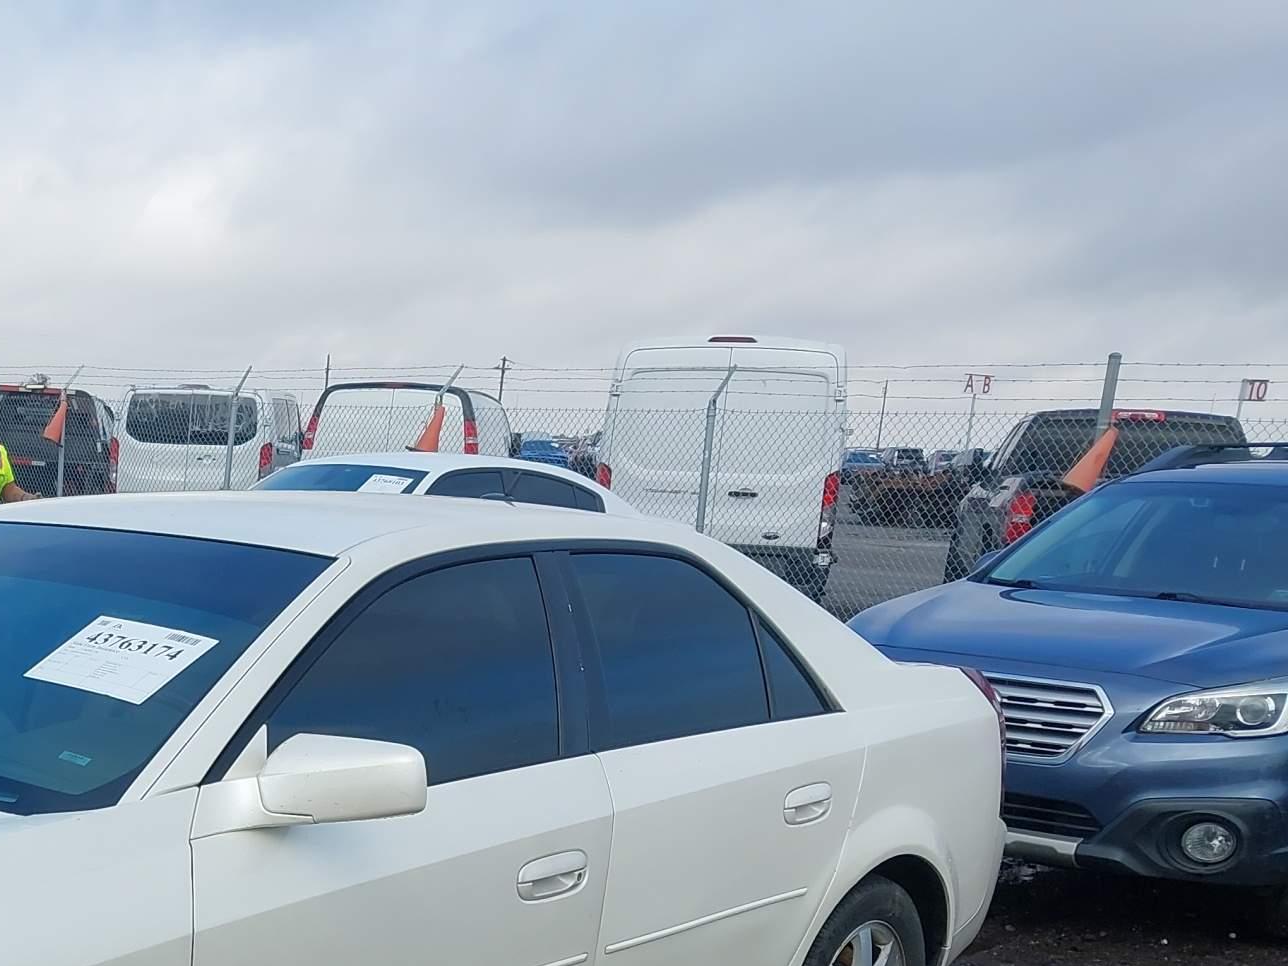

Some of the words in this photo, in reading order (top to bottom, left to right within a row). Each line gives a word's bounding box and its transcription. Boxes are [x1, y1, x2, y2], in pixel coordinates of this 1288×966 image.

[964, 375, 974, 393] A
[982, 376, 992, 394] B
[1248, 382, 1268, 400] 10
[86, 631, 185, 661] 43763174
